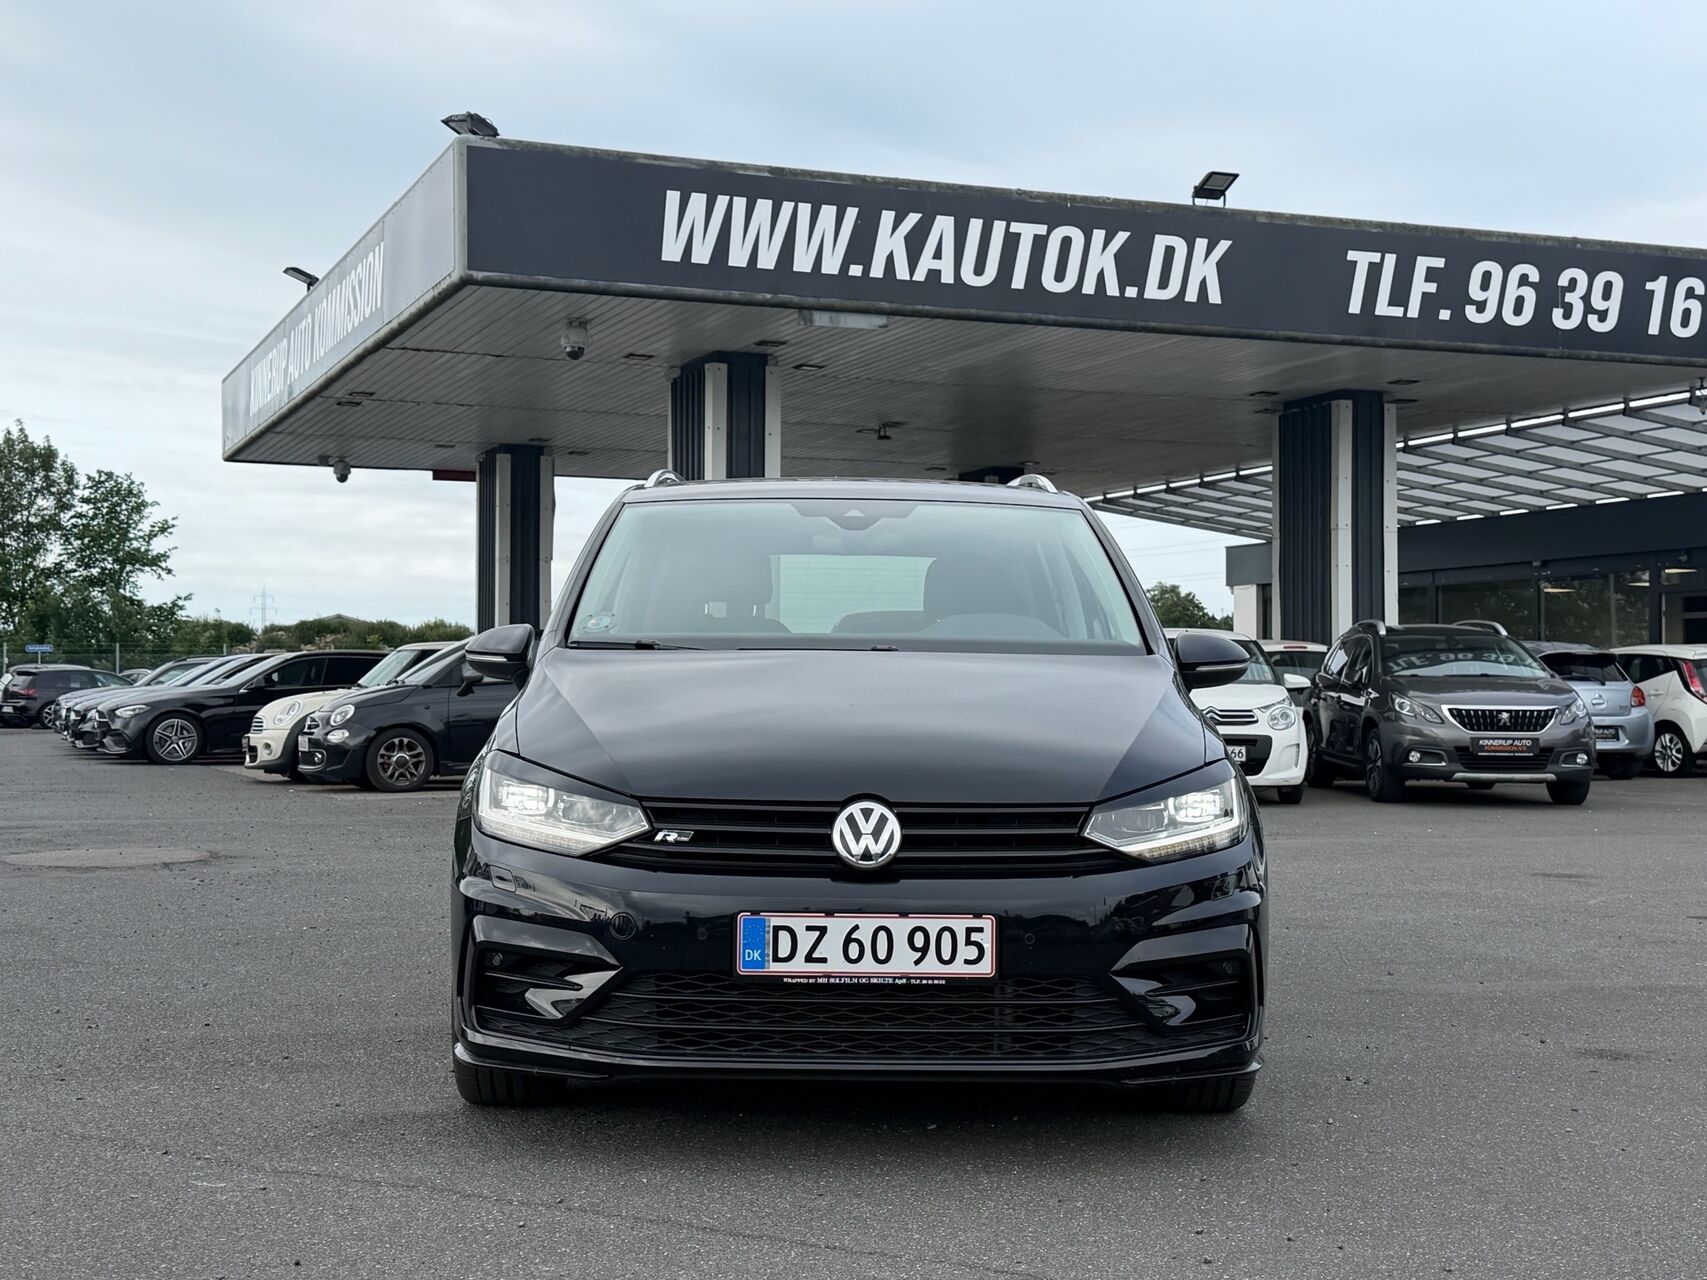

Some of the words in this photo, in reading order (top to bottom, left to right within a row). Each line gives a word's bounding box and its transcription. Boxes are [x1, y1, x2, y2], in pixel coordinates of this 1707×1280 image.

[661, 189, 1233, 305] WWW.KAUTOK.DK
[1346, 250, 1451, 321] TLF.
[1465, 260, 1540, 327] 96
[1552, 267, 1624, 333] 39
[1645, 275, 1706, 338] 16
[250, 337, 288, 417] KINNERUP
[287, 313, 312, 385] AUTO
[313, 241, 384, 364] KOMMISSION
[1228, 748, 1244, 759] 66
[745, 949, 762, 961] DK
[771, 925, 828, 964] DZ
[842, 923, 894, 966] 60
[907, 925, 985, 967] 905
